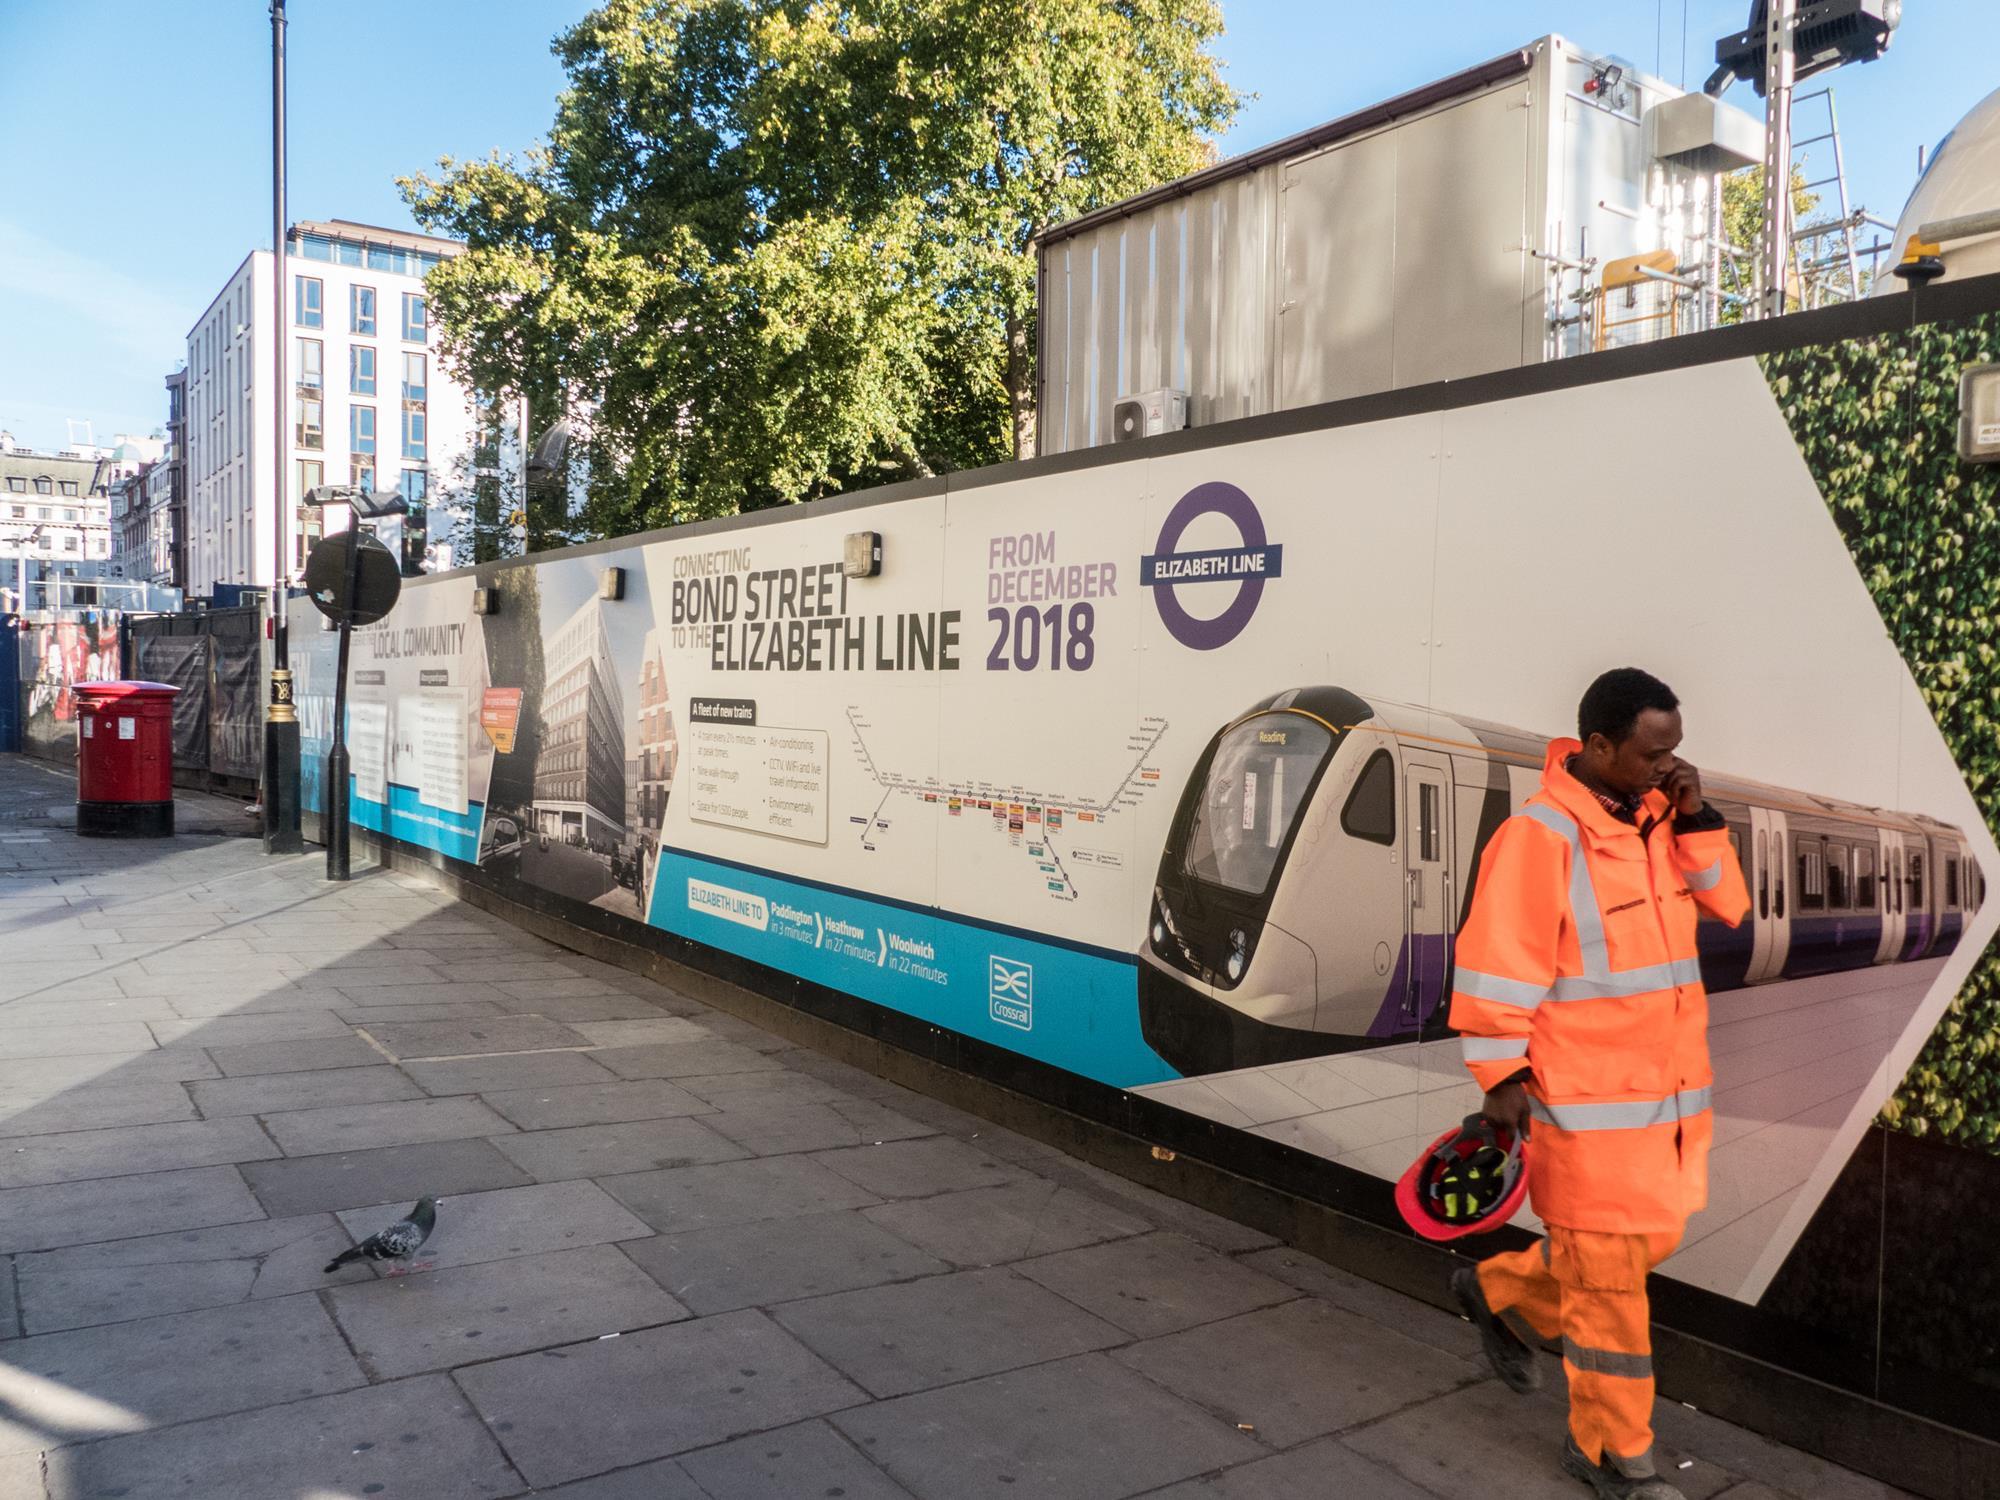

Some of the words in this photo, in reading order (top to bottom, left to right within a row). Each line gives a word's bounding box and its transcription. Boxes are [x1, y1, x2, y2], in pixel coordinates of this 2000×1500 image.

[673, 547, 751, 579] CONNECTING
[988, 531, 1056, 570] FROM
[1154, 556, 1229, 579] ELIZABETH
[1232, 553, 1265, 574] LINE
[671, 574, 738, 625] BOND
[744, 562, 849, 621] STREET
[987, 562, 1118, 605] DECEMBER
[373, 630, 401, 660] LOCAL
[403, 622, 466, 657] COMMUNITY
[671, 625, 686, 649] TO
[689, 623, 711, 648] THE
[711, 616, 866, 671] ELIZABETH
[875, 610, 961, 671] LINE
[986, 602, 1095, 672] 2018
[692, 703, 698, 716] A
[698, 702, 712, 717] fleet
[712, 704, 720, 717] of
[720, 707, 734, 718] new
[733, 705, 753, 720] trains
[1259, 730, 1286, 746] Reading
[691, 886, 731, 910] ELIZABETH
[732, 898, 750, 917] LINE
[751, 903, 762, 920] TO
[771, 901, 813, 927] Paddington
[771, 920, 779, 933] in
[779, 921, 784, 935] 3
[784, 924, 814, 945] minutes
[825, 915, 865, 940] Heathrow
[825, 934, 833, 950] in
[833, 937, 844, 952] 27
[843, 942, 877, 964] minutes
[888, 933, 935, 961] Woolwich
[889, 952, 898, 969] in
[898, 956, 911, 974] 22
[910, 962, 949, 986] minutes
[994, 1000, 1028, 1024] Crossrail
